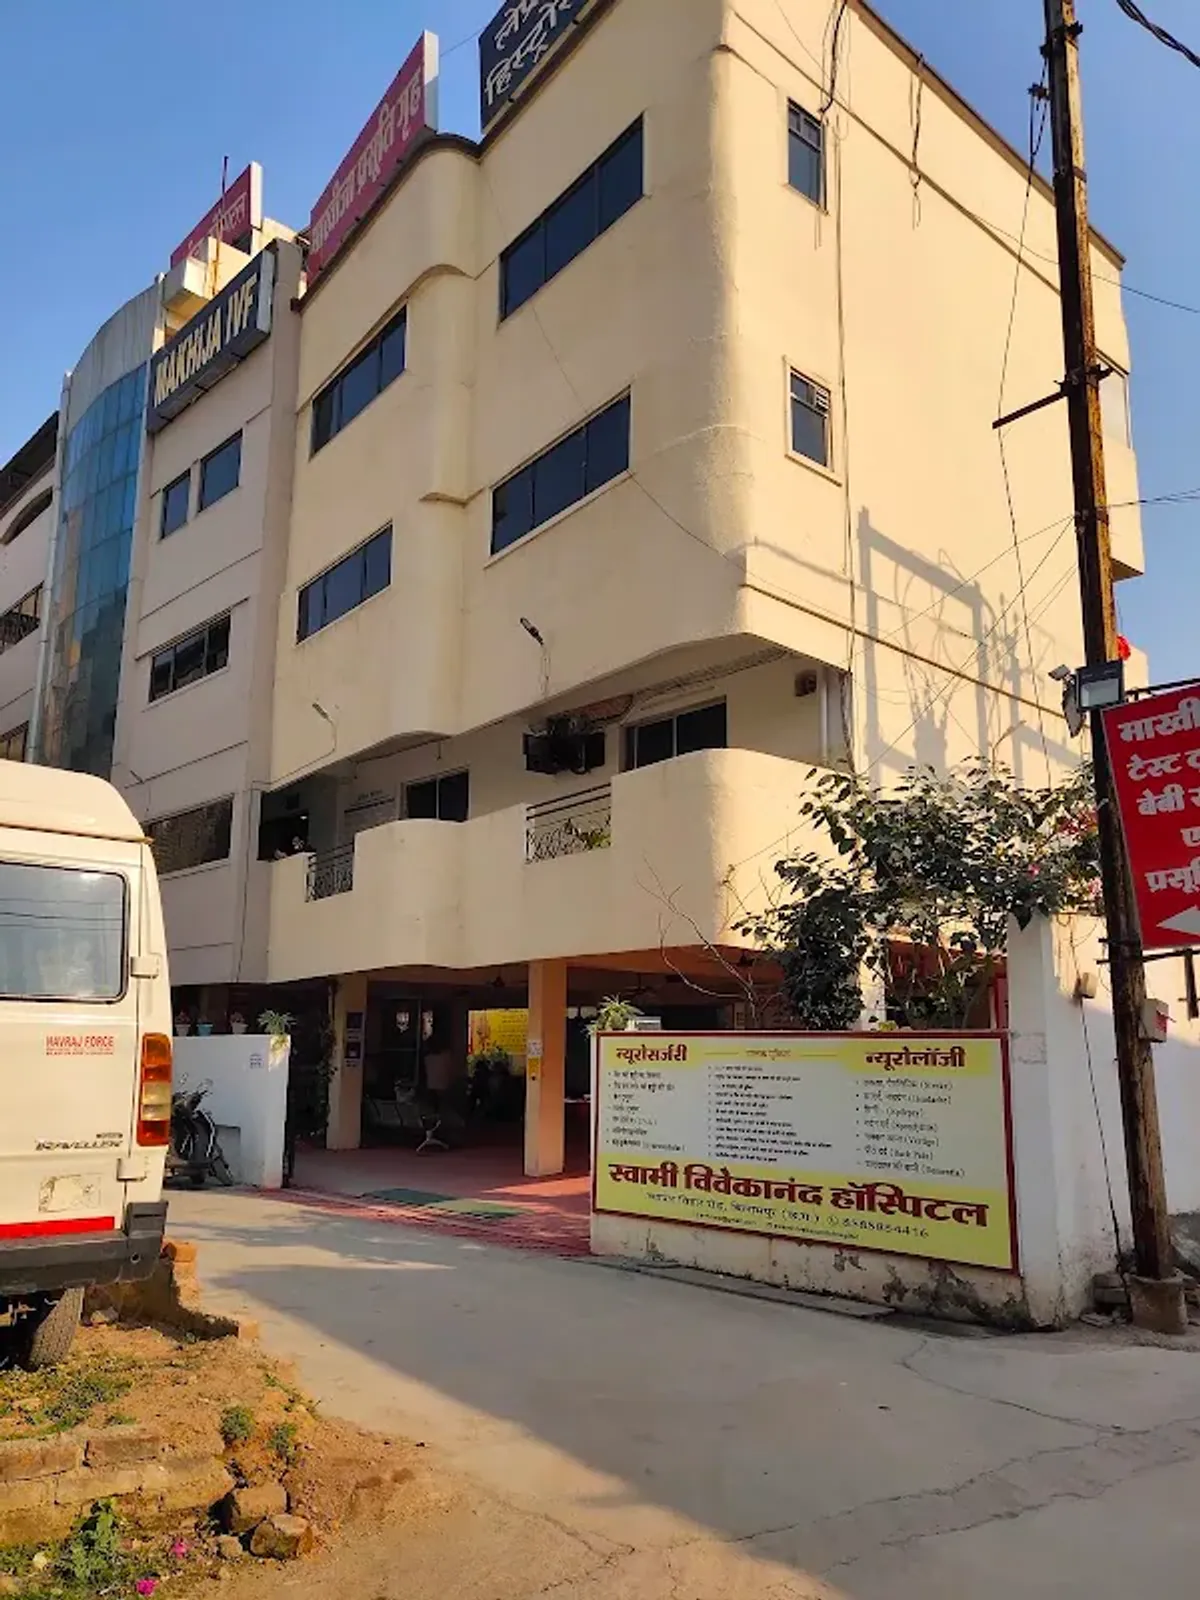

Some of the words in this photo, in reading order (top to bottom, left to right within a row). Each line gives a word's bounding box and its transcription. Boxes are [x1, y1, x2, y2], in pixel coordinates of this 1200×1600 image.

[224, 272, 258, 345] IVF
[1126, 753, 1183, 781] टेस्ट
[1136, 783, 1185, 815] बेबी
[84, 1036, 114, 1047] FORCE
[616, 1044, 688, 1064] न्यूरोसर्जरी
[866, 1046, 966, 1071] न्यूरोलॉजी
[608, 1160, 678, 1188] स्वामी
[684, 1164, 823, 1205] विवेकानंद
[830, 1182, 989, 1227] हॉस्पिटल
